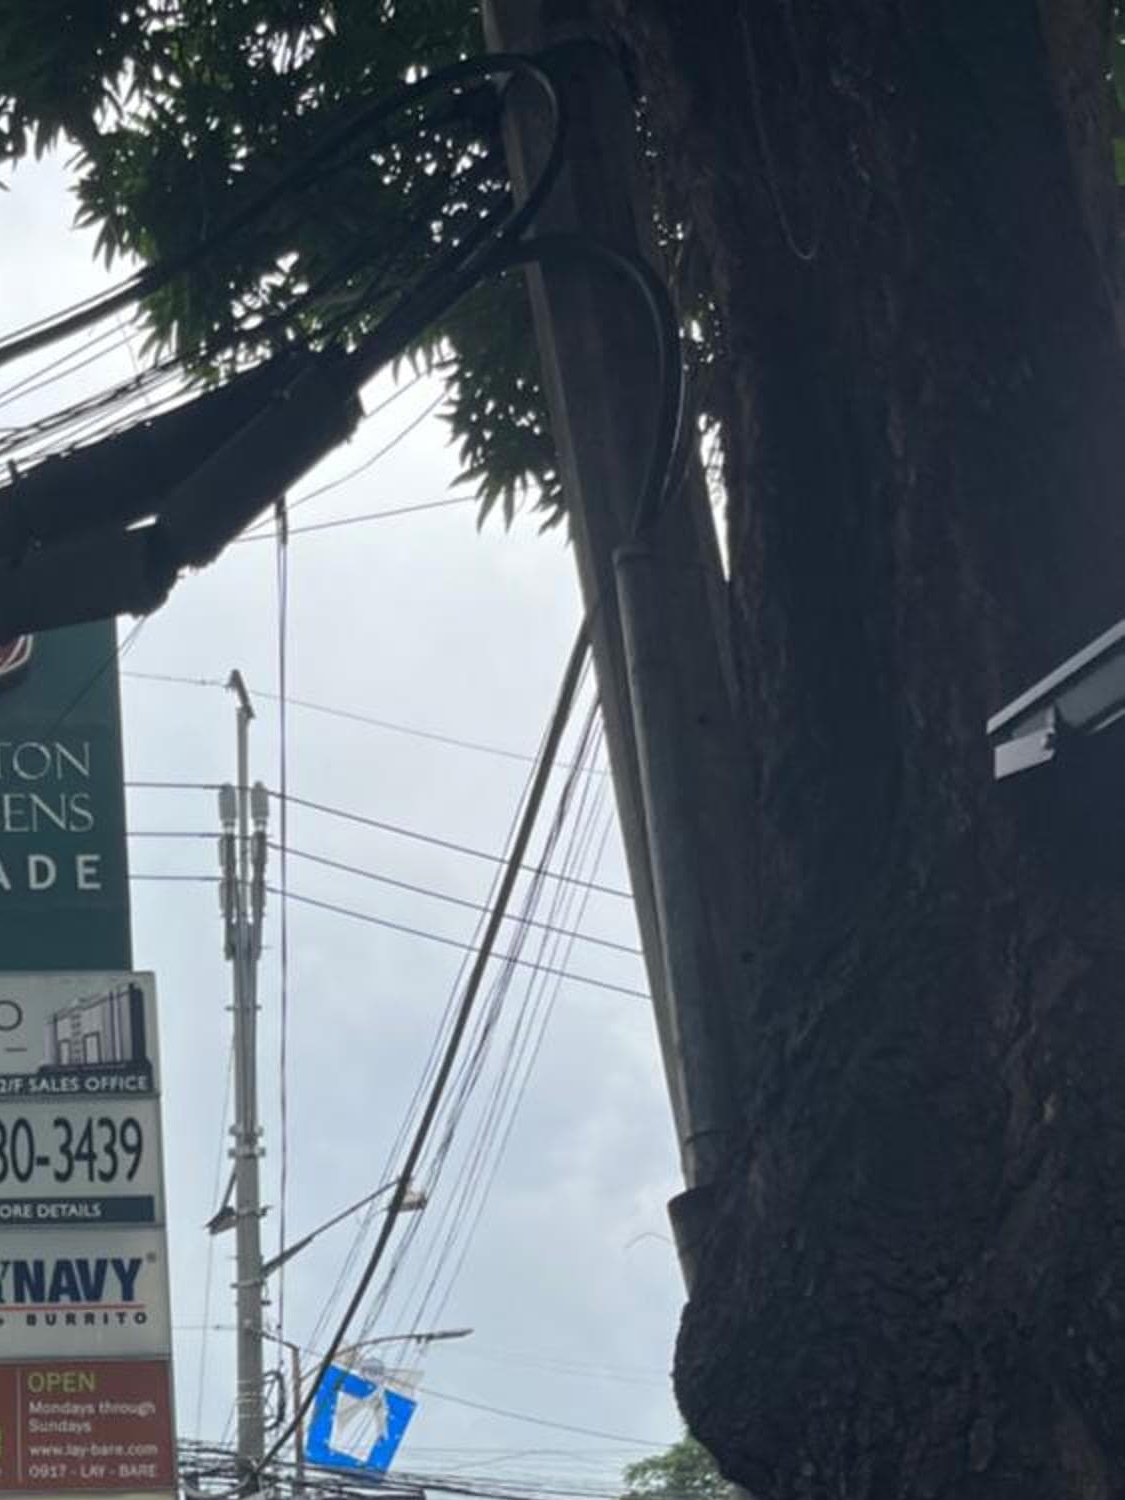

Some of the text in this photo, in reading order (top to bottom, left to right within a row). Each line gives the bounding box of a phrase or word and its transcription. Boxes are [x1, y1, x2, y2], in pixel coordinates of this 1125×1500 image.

[29, 1076, 79, 1093] SALES
[84, 1075, 148, 1091] OFFICE
[36, 1203, 102, 1218] DETAILS
[26, 1310, 148, 1327] BURRITO
[27, 1371, 96, 1393] OPEN
[28, 1400, 156, 1418] Mondays through
[28, 1417, 92, 1435] Sundays
